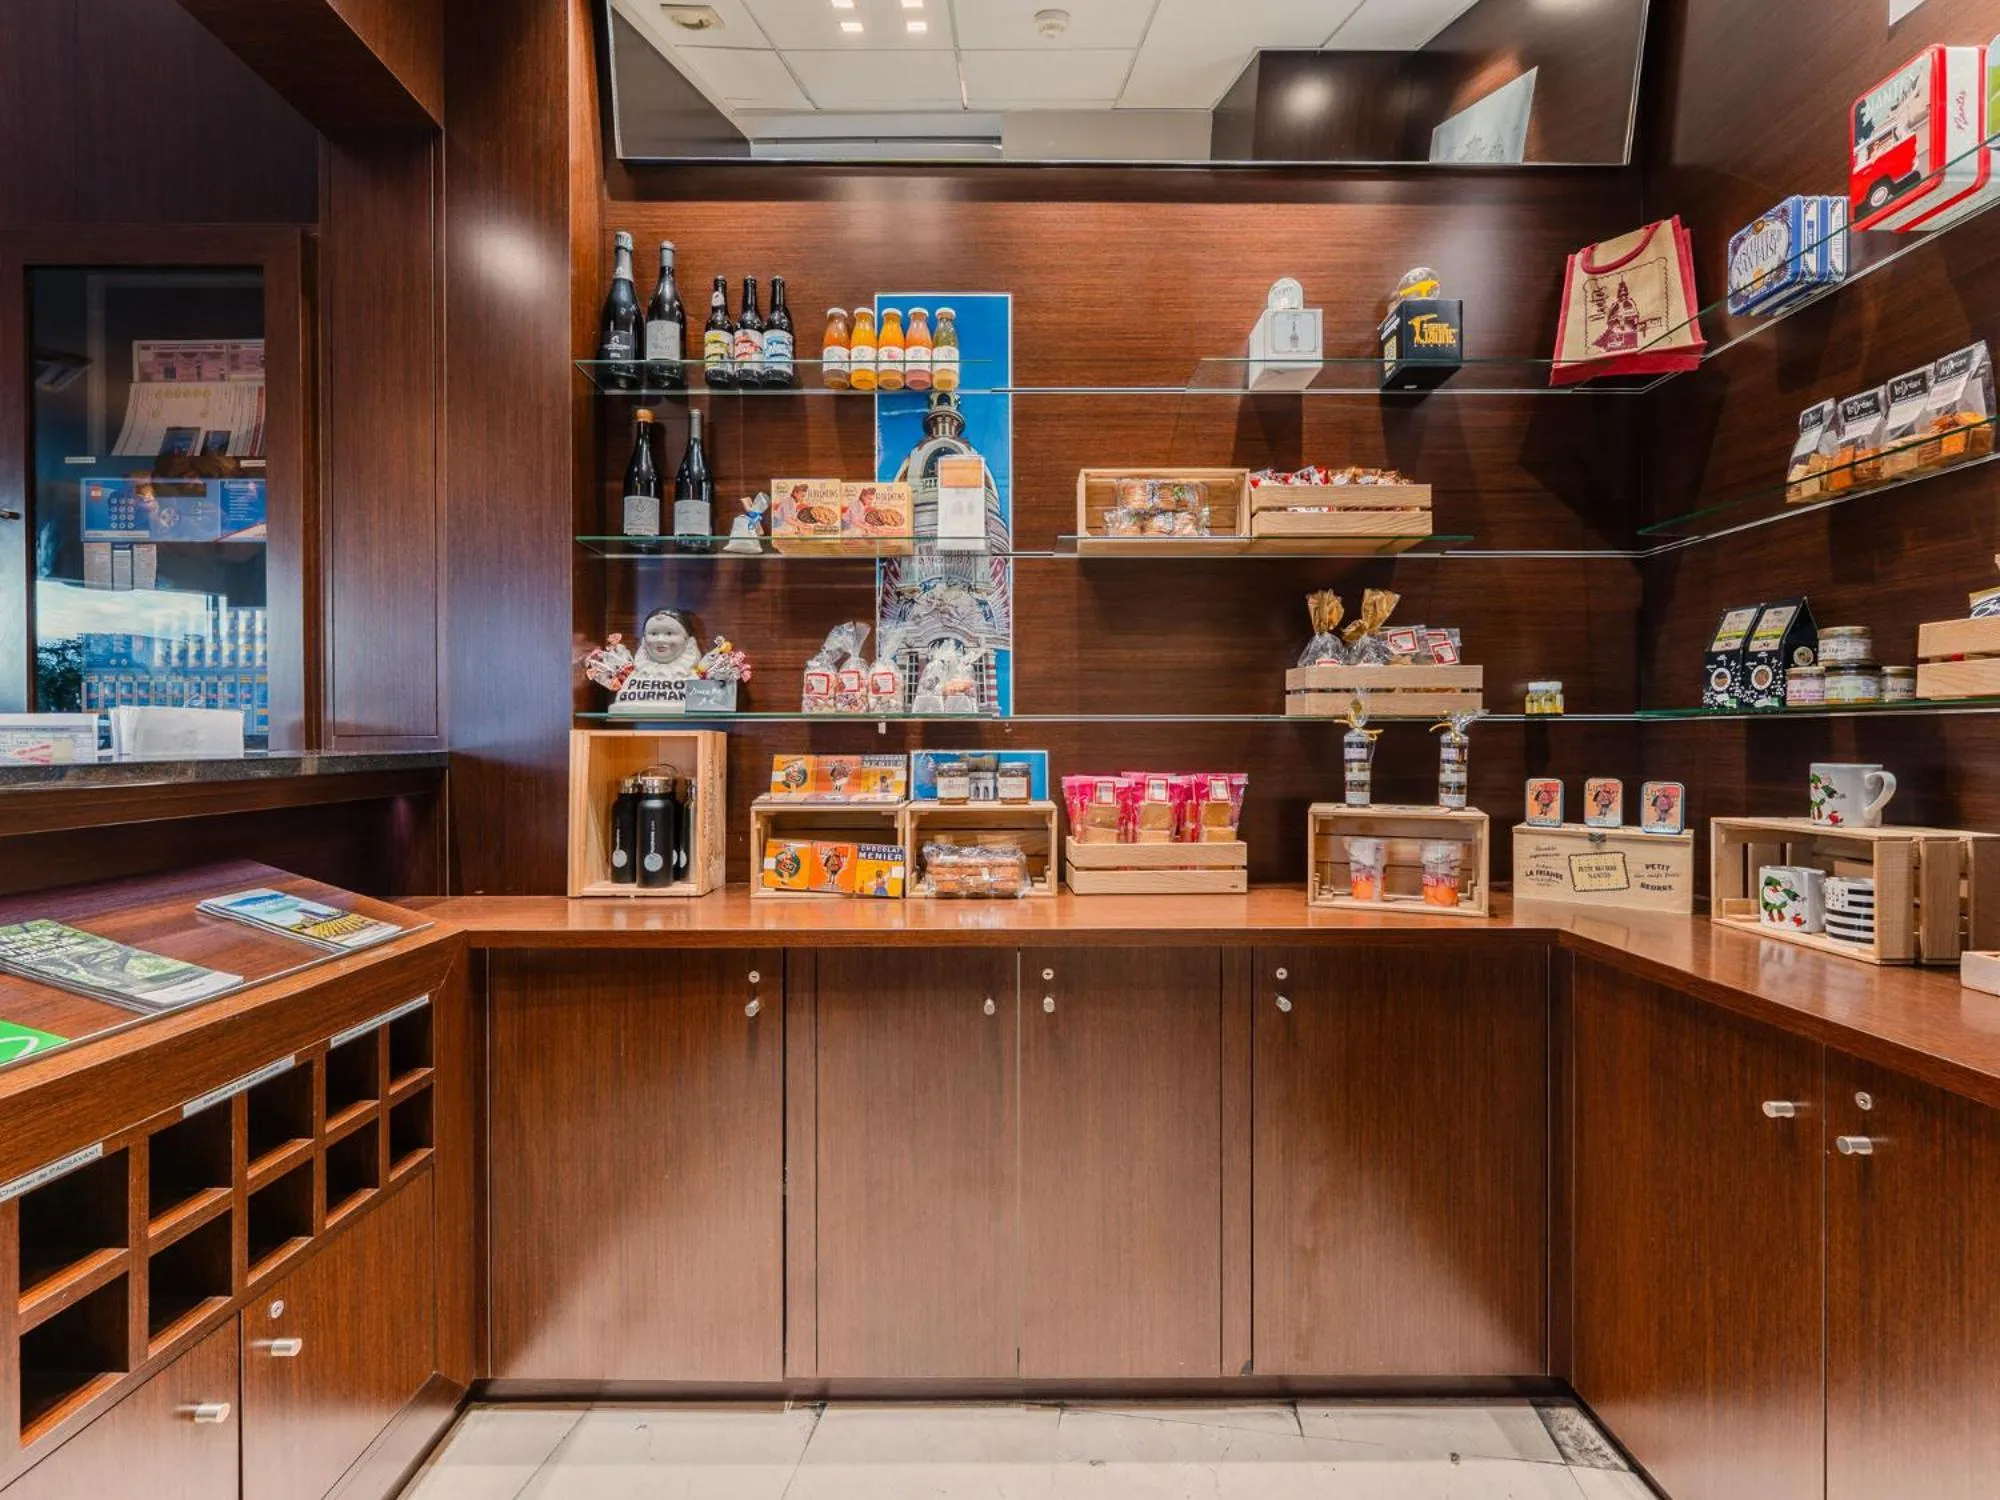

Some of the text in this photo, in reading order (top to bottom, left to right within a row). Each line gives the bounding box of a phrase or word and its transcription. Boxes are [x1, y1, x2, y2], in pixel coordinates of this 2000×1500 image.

[628, 679, 685, 690] PIERRO
[619, 691, 686, 701] GOURMAN
[861, 845, 902, 854] CHOCOLAT
[859, 852, 902, 861] MENIER
